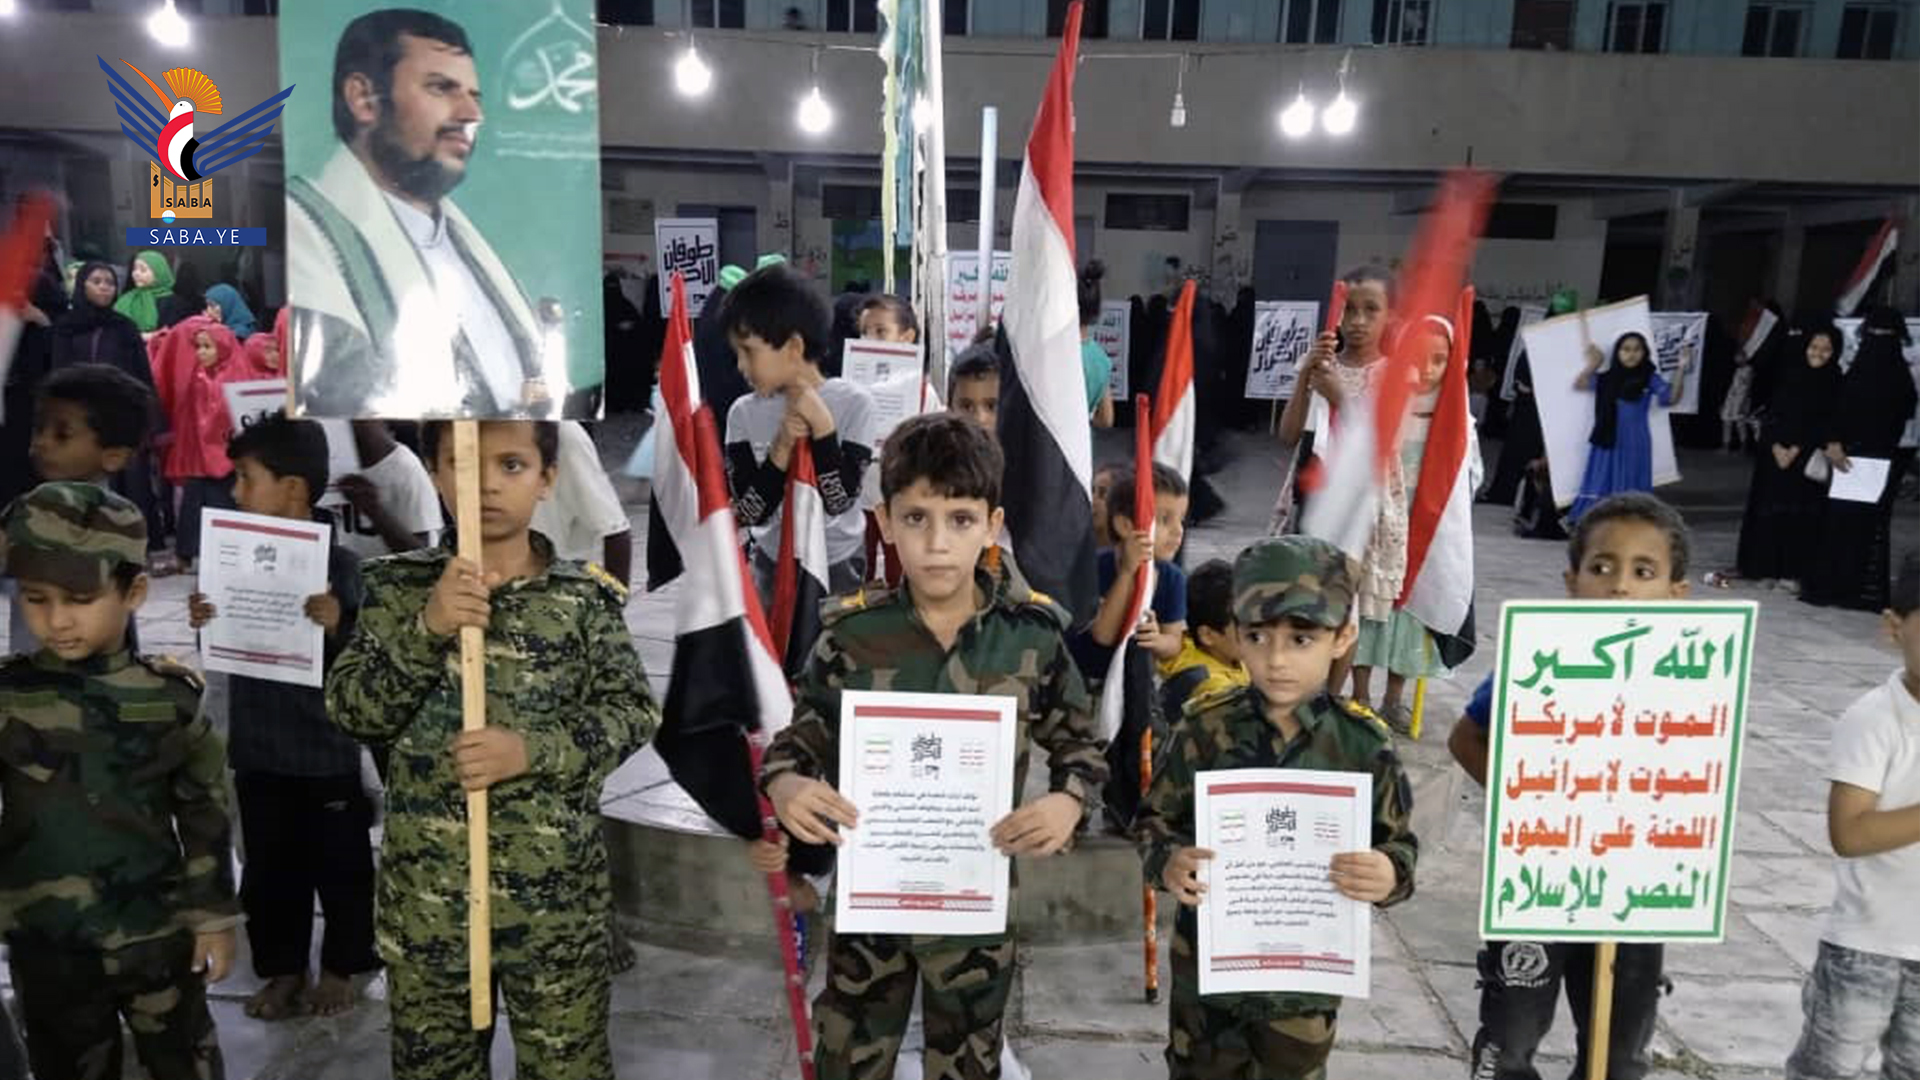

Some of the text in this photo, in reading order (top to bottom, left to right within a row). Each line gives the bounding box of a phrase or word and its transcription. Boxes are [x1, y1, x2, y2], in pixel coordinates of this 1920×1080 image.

[663, 235, 714, 270] طوفان
[1512, 618, 1736, 696] الله أكبر
[1511, 695, 1728, 744] الموت لأمريكا
[1506, 757, 1722, 803] الموت لإسرائيل
[1501, 814, 1717, 856] اللعنة على اليهود
[1498, 863, 1710, 923] النصر للإسلام
